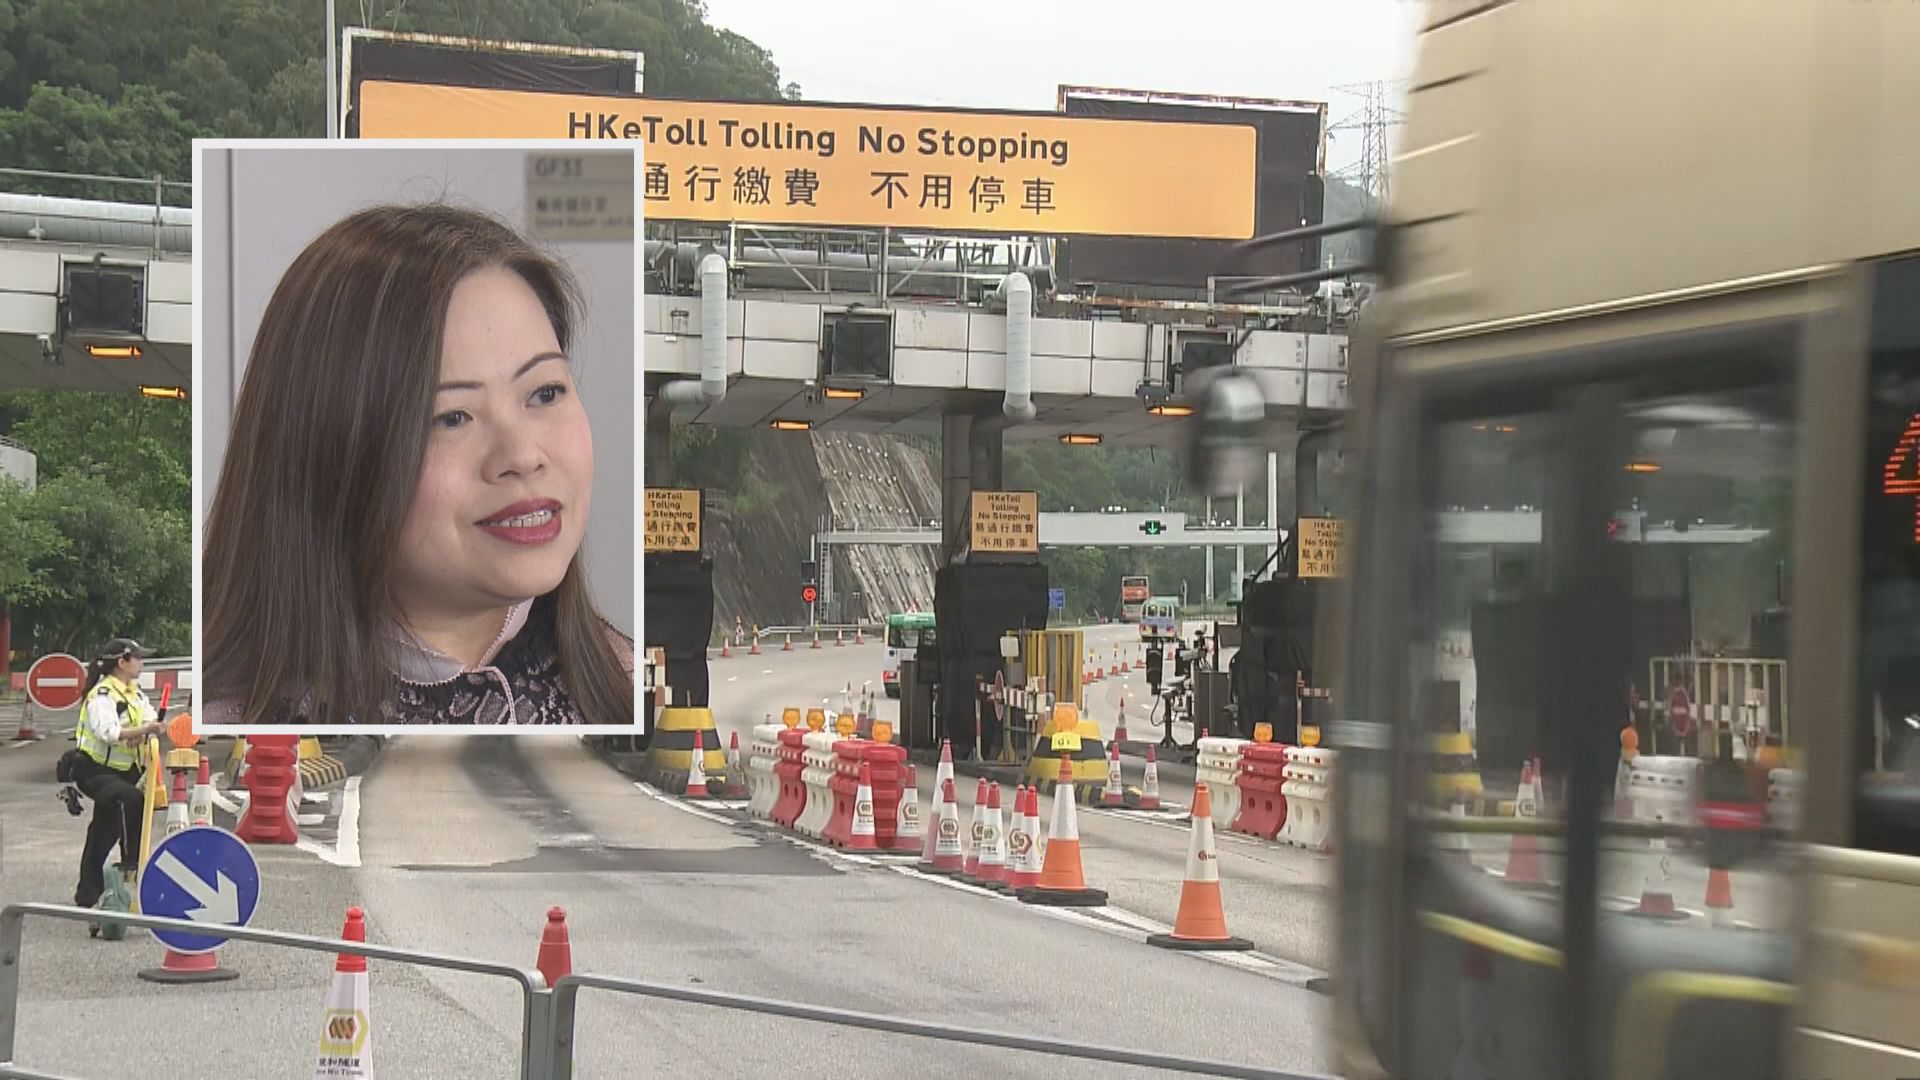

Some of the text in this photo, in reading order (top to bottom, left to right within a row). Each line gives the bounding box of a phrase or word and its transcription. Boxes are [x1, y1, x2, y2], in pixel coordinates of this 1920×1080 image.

[568, 112, 1069, 166] HKeToll Tolling No Stopping
[870, 171, 1057, 216] 不用停車
[648, 491, 683, 500] HKeToll
[987, 494, 1021, 503] HKeToll
[651, 500, 681, 511] Tolling
[991, 503, 1019, 513] Tolling
[978, 511, 1031, 521] No Stopping
[1305, 538, 1317, 548] No
